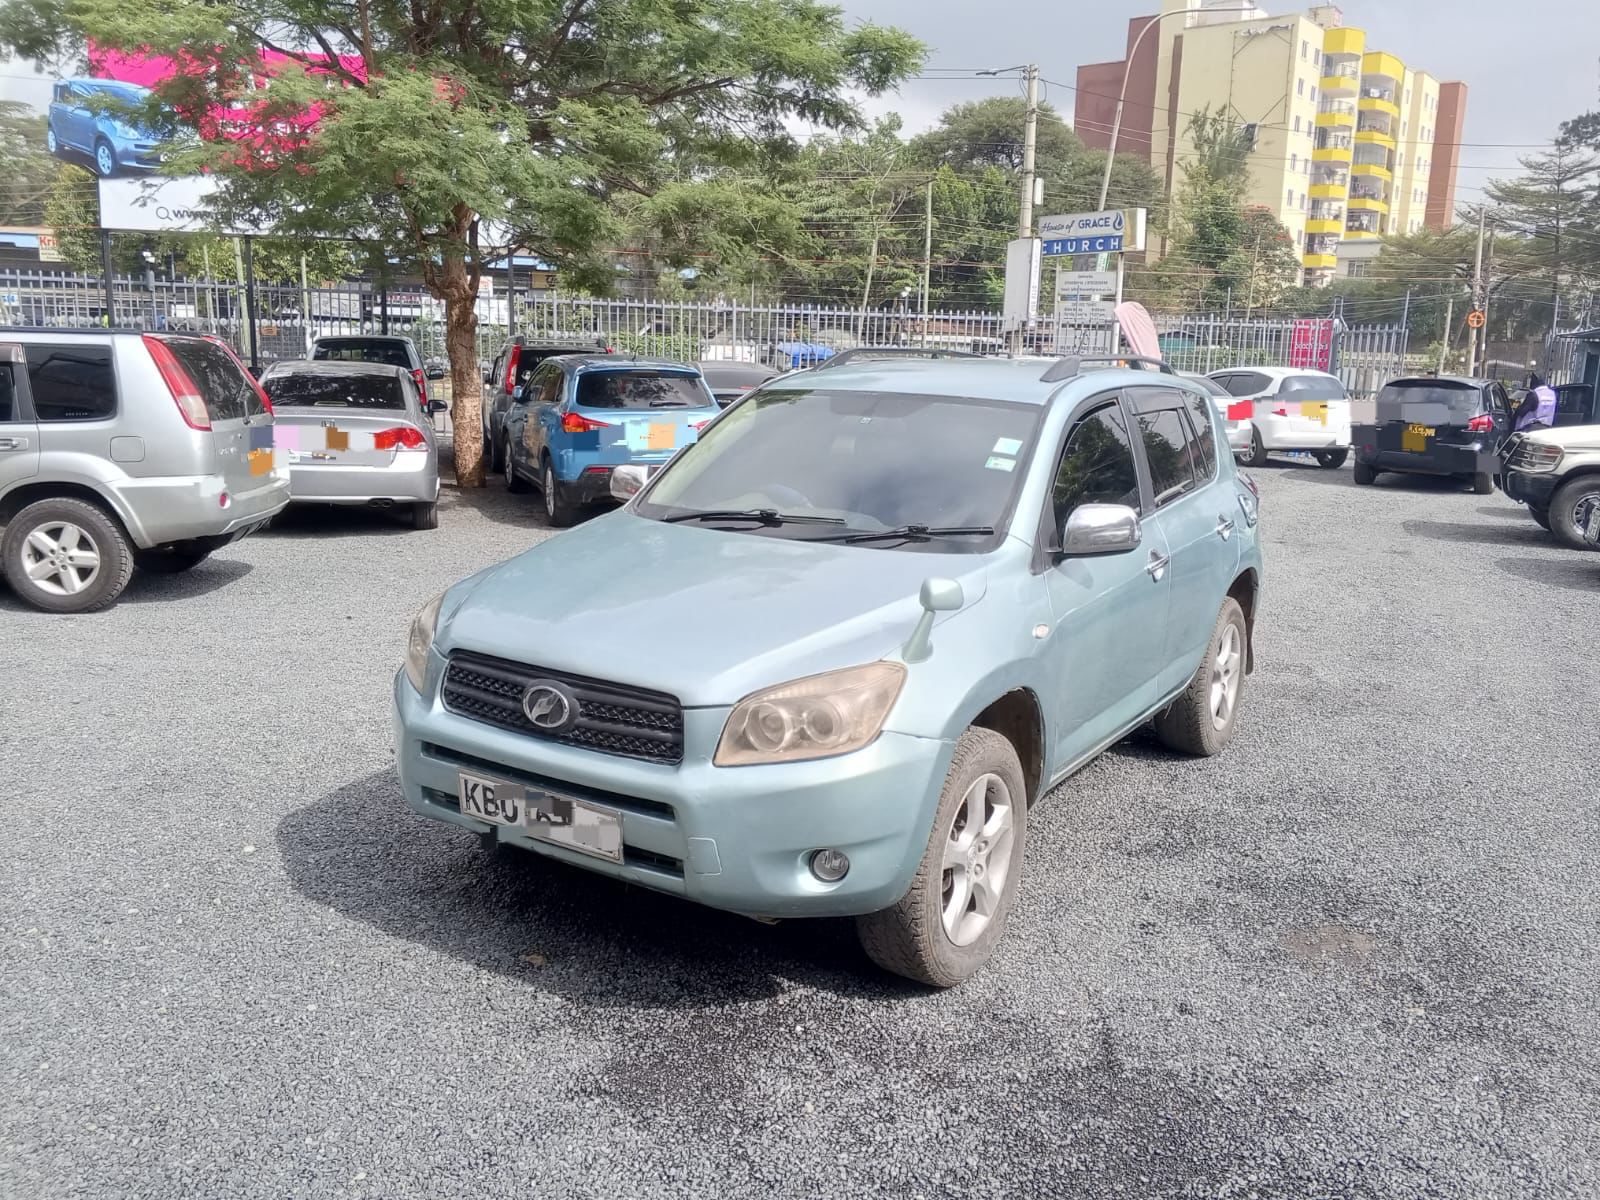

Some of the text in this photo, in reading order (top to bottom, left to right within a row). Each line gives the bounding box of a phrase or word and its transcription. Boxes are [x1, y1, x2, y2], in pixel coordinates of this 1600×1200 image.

[1041, 216, 1111, 233] House of GRACE
[1042, 238, 1119, 255] CHURCH
